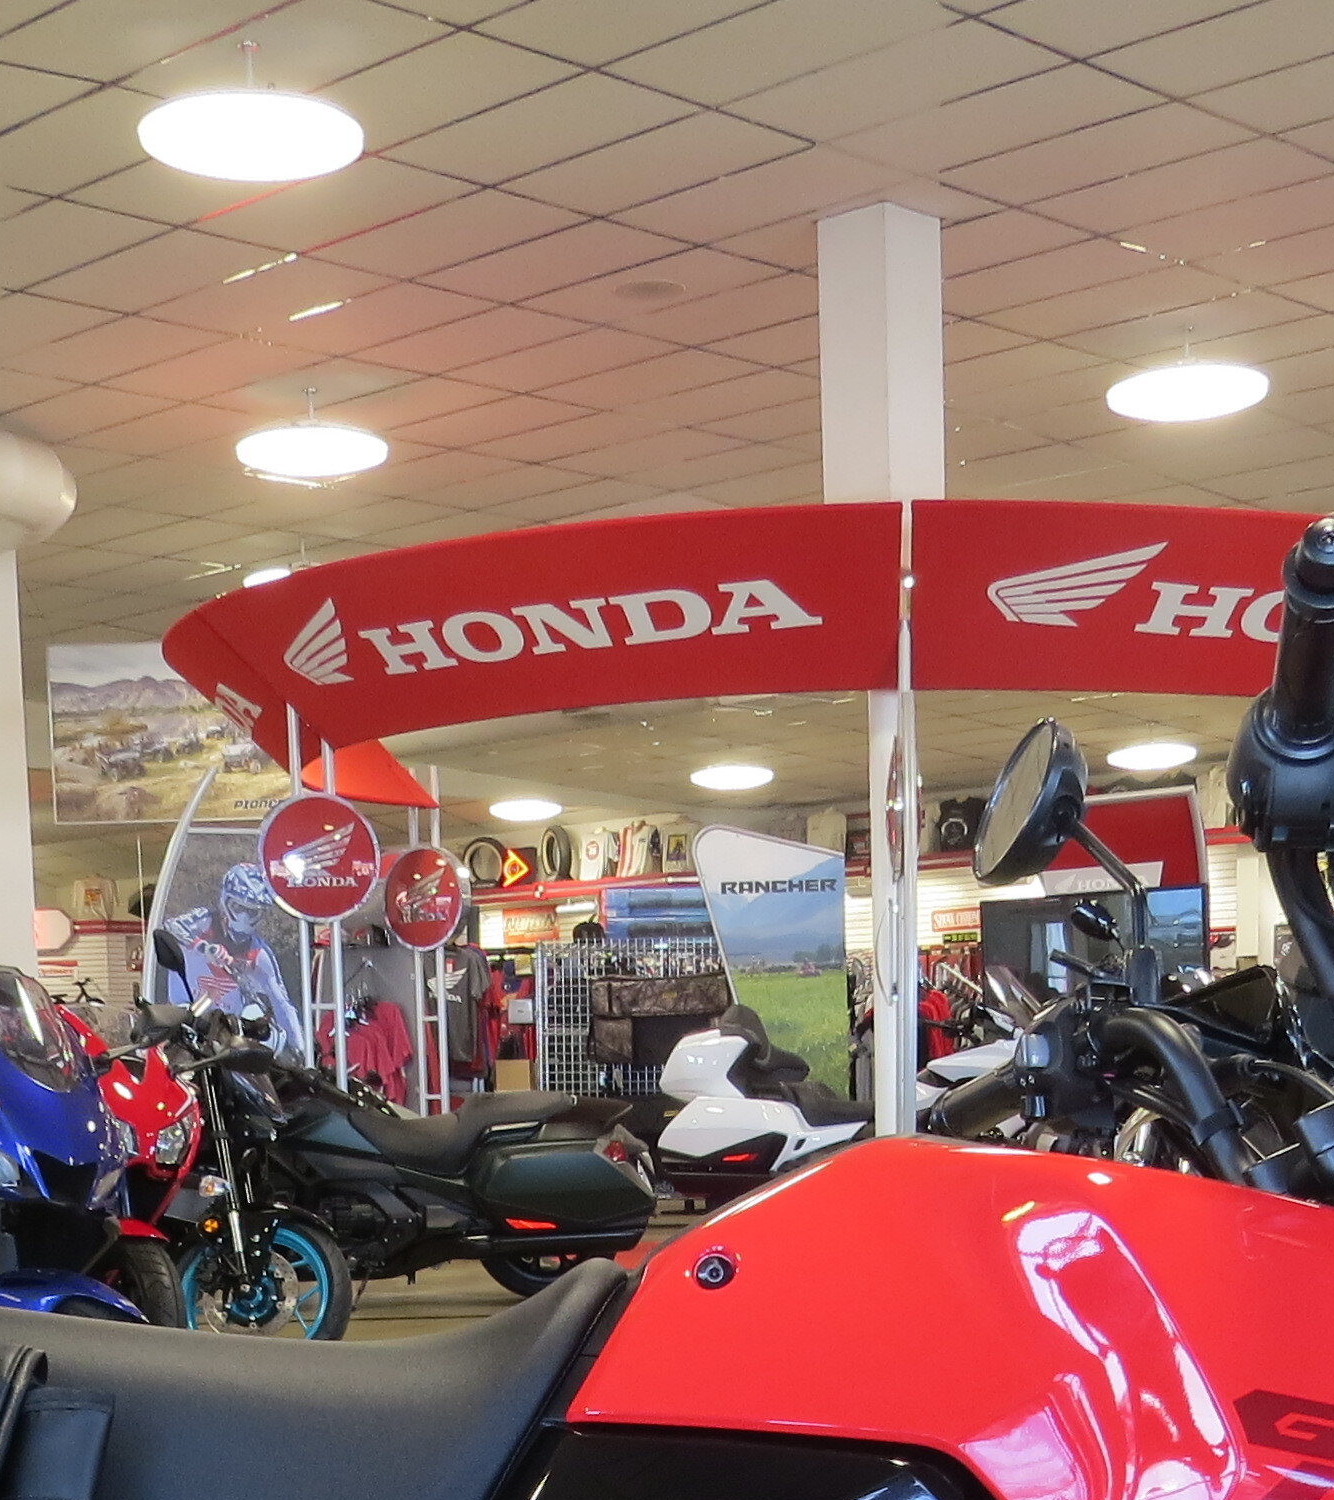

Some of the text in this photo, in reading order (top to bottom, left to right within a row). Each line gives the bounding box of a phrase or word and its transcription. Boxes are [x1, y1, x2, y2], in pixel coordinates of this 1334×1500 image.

[357, 578, 823, 676] HONDA
[286, 875, 358, 888] HONDA
[721, 879, 837, 896] RANCHER
